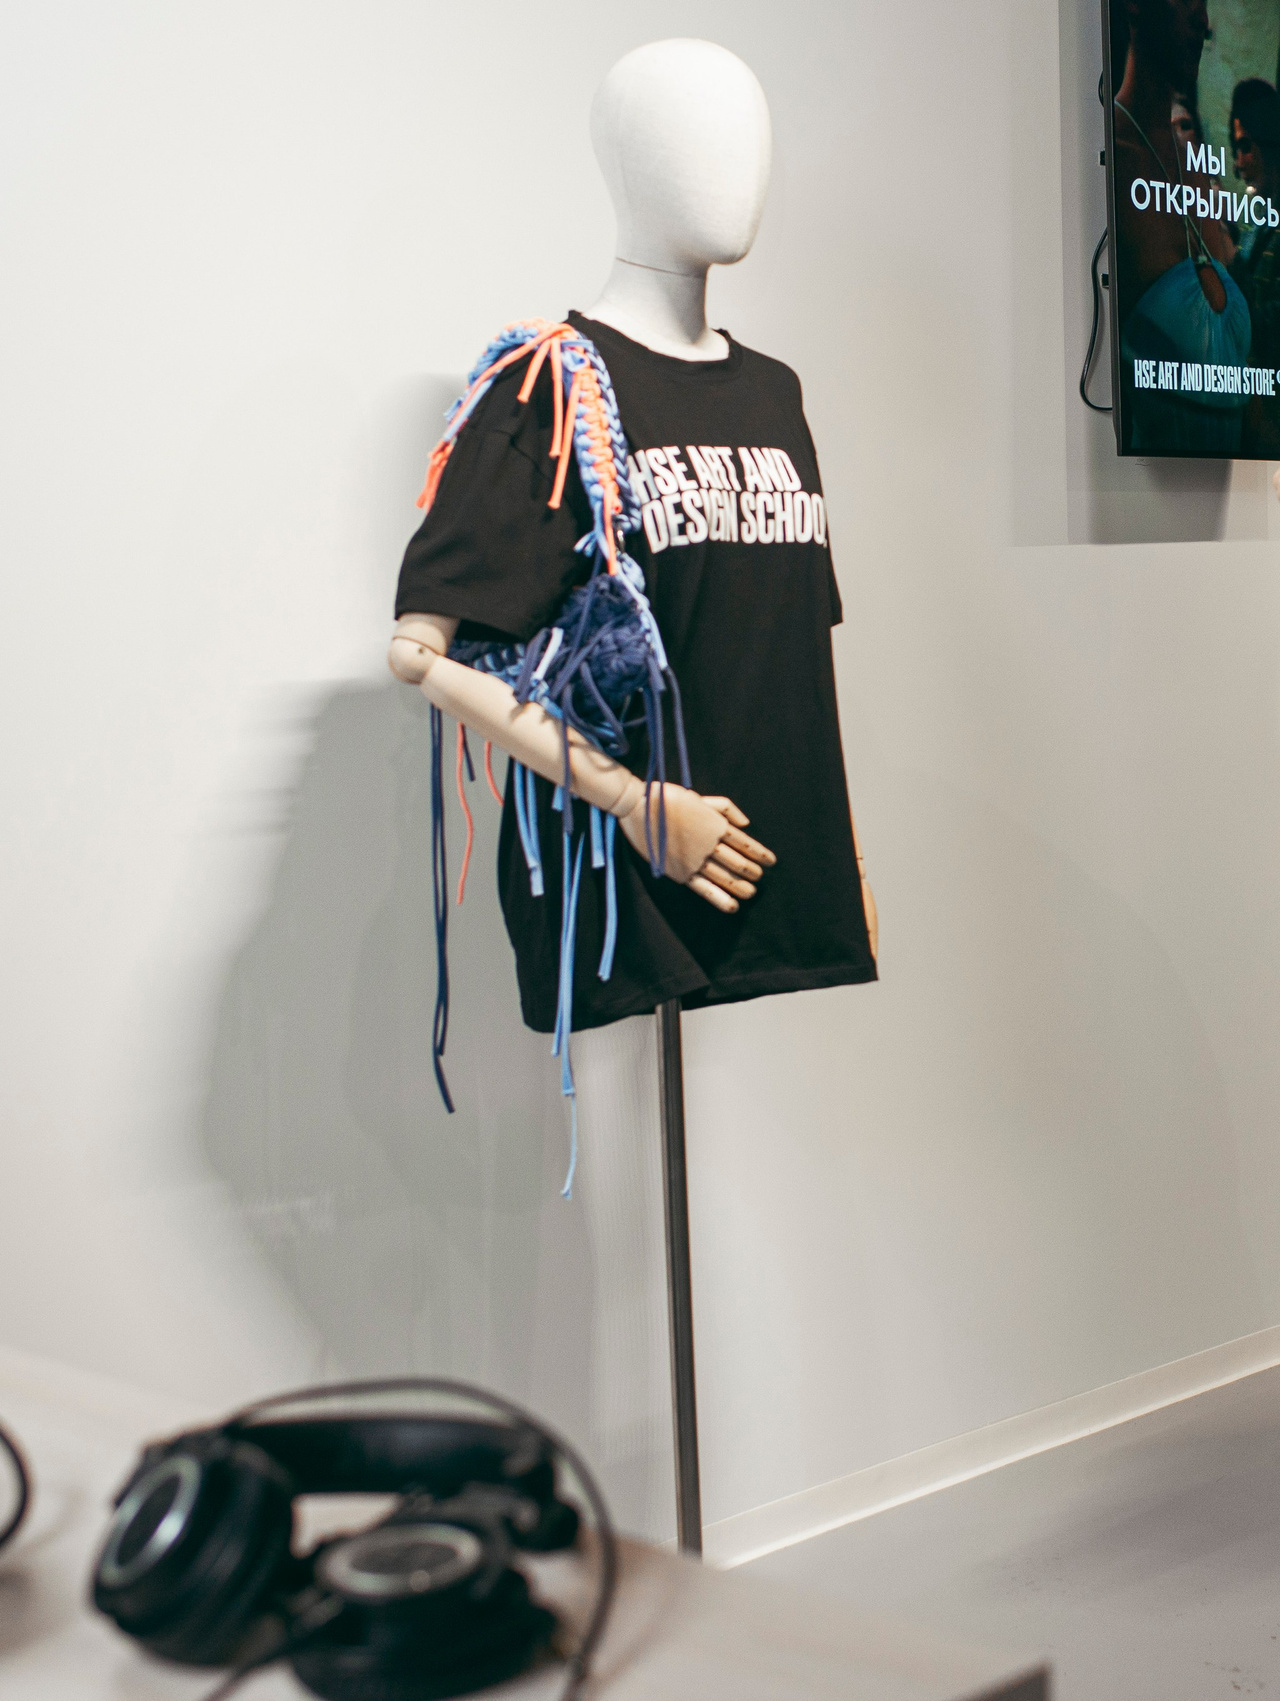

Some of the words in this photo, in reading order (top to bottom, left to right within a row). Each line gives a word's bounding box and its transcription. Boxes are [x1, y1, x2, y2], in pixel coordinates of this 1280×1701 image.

[1186, 141, 1226, 177] МЫ
[1130, 177, 1280, 228] ОТКРЫЛИСЬ
[1134, 359, 1157, 388] HSE
[1158, 361, 1179, 390] ART
[1181, 362, 1203, 391] AND
[1204, 364, 1242, 394] DESIGN
[626, 446, 698, 504] HSE
[685, 445, 742, 492] ART
[738, 447, 802, 492] AND
[641, 489, 738, 554] DESIGN
[740, 491, 828, 548] SCHOO
